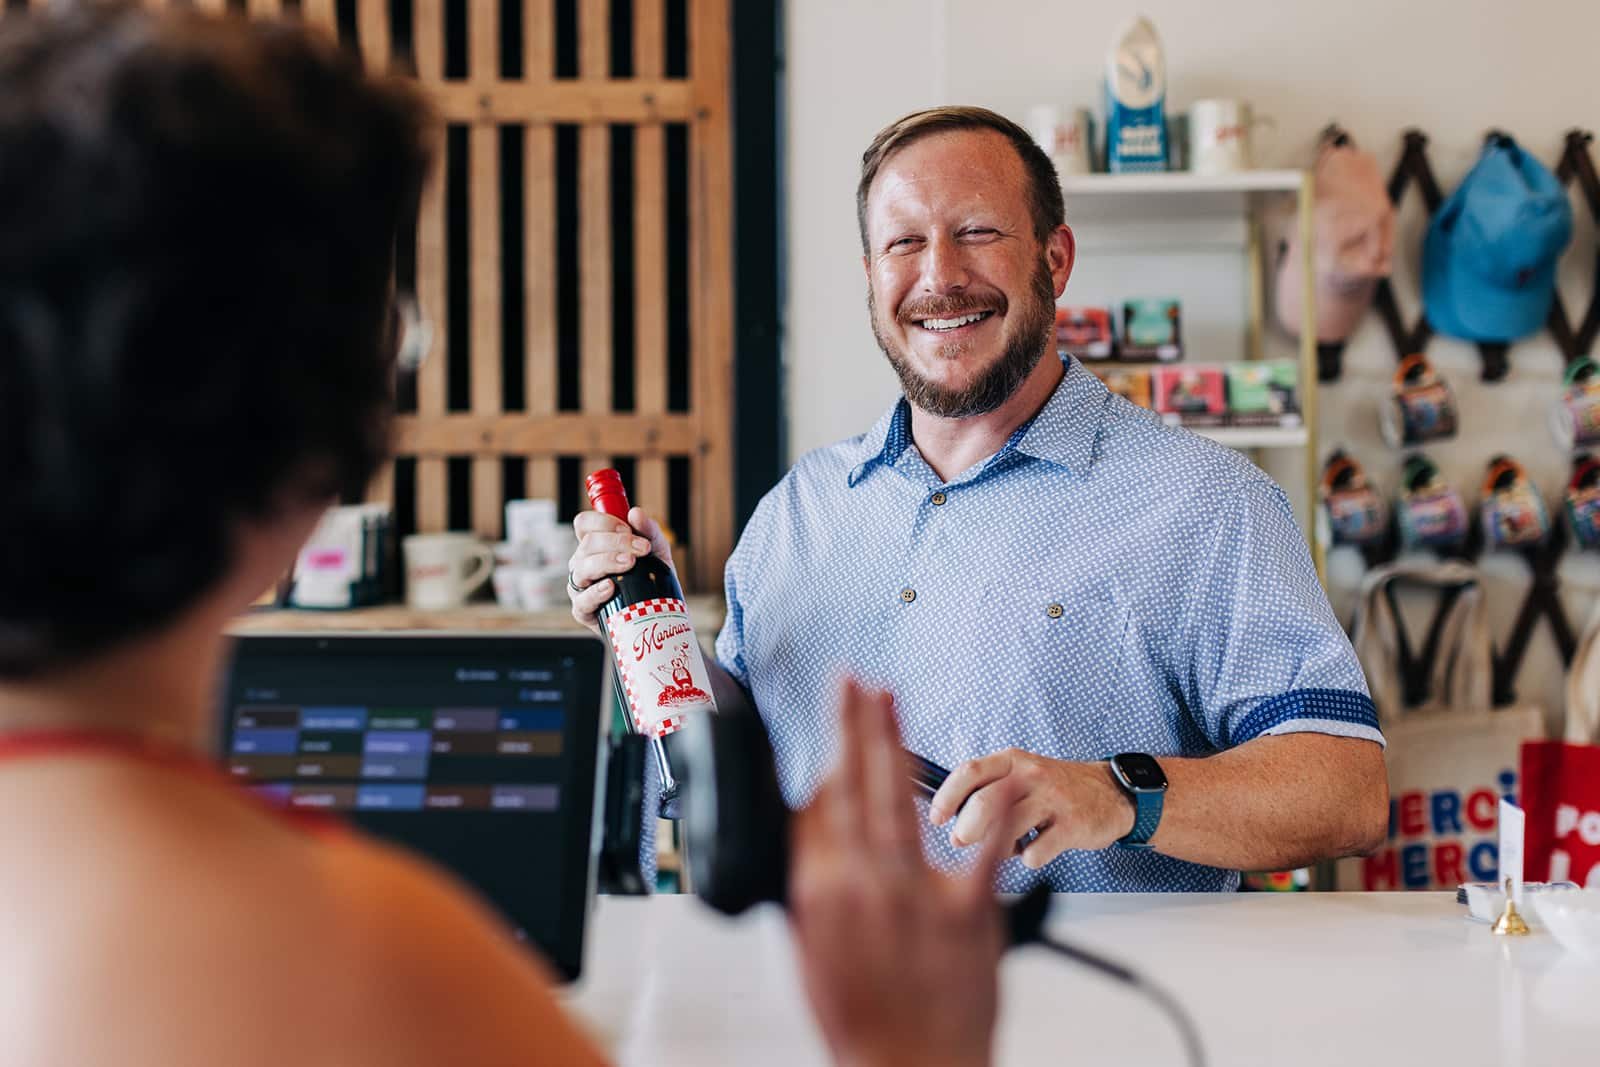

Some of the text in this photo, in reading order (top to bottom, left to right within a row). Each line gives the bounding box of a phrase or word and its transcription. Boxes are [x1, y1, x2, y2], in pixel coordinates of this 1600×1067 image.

[633, 622, 693, 661] Marinar
[1389, 769, 1519, 836] ERCi
[1361, 840, 1499, 891] MERC
